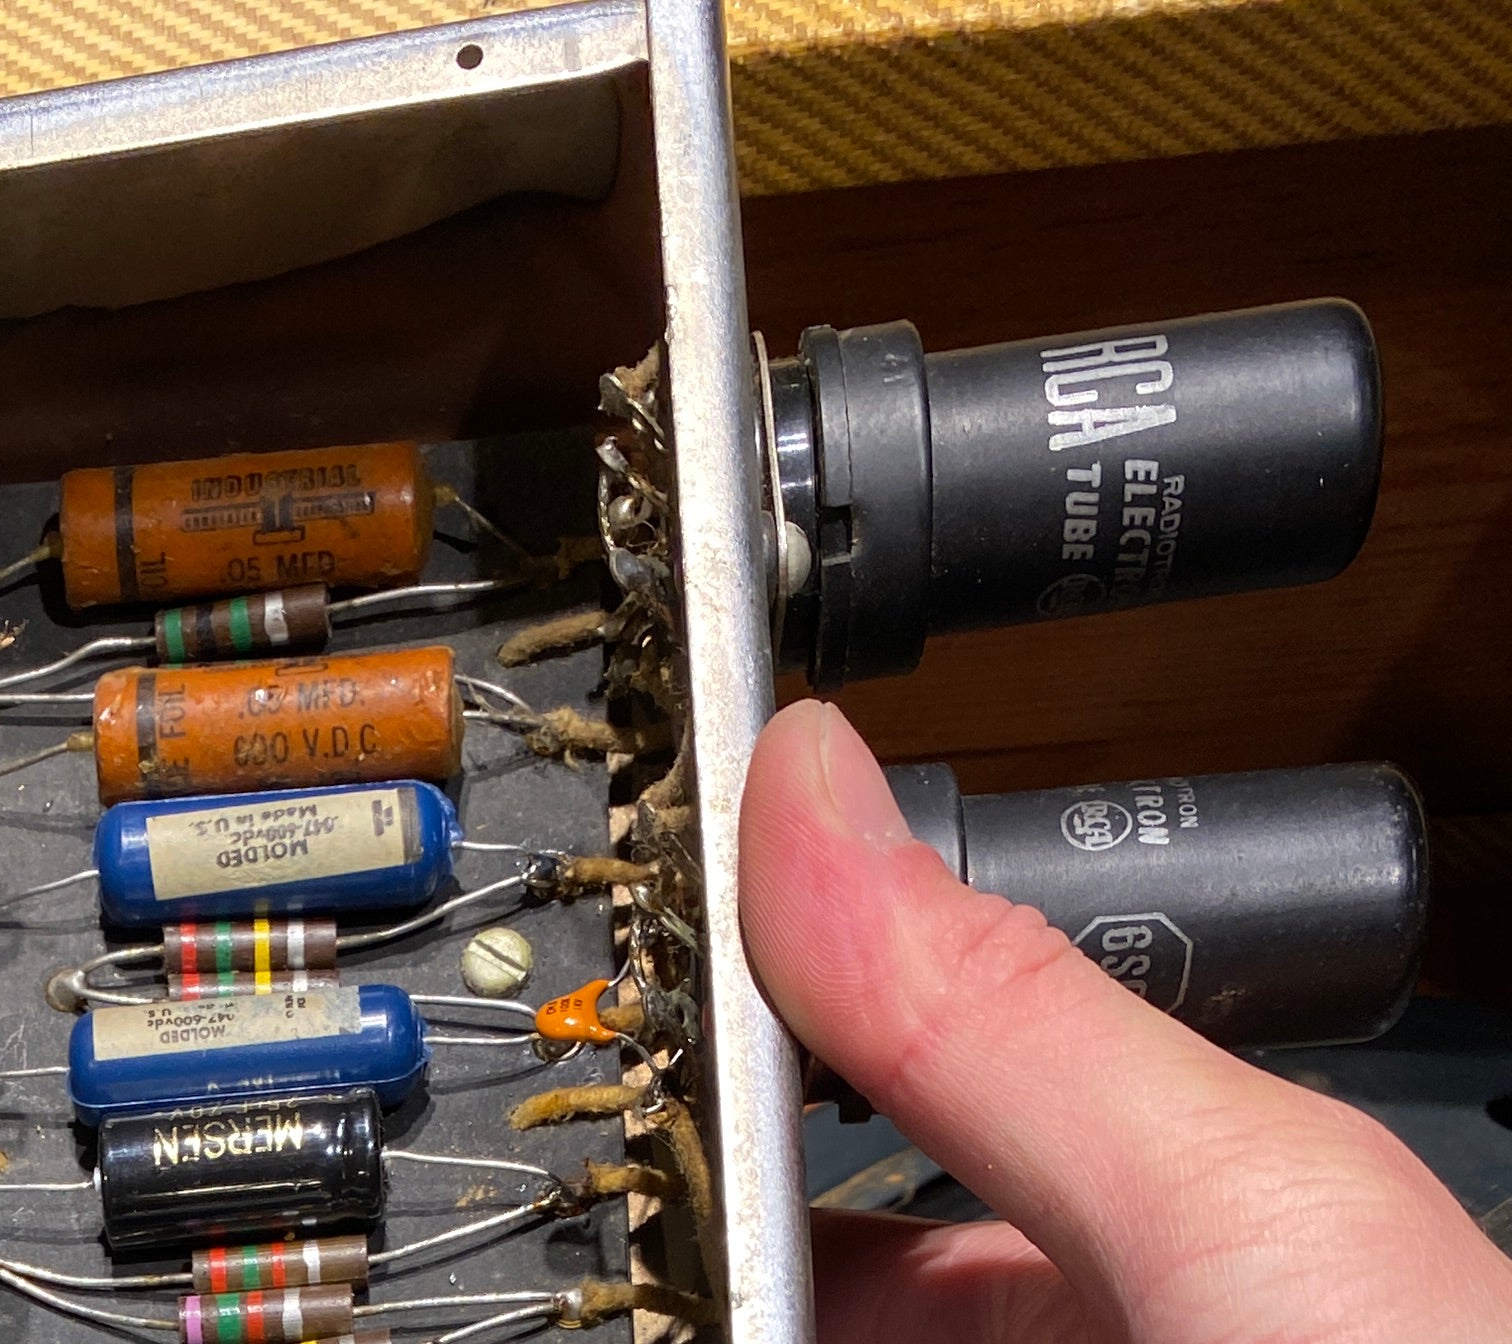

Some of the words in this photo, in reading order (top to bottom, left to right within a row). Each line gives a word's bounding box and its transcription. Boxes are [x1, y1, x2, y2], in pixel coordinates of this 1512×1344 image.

[1040, 334, 1176, 451] RCA
[192, 464, 360, 499] INDUSTRIAL
[1062, 461, 1102, 560] TUBE
[160, 684, 187, 740] FOIL
[216, 838, 309, 869] MOLDED
[159, 1025, 226, 1045] MOLDED
[153, 1111, 303, 1166] MERSEN
